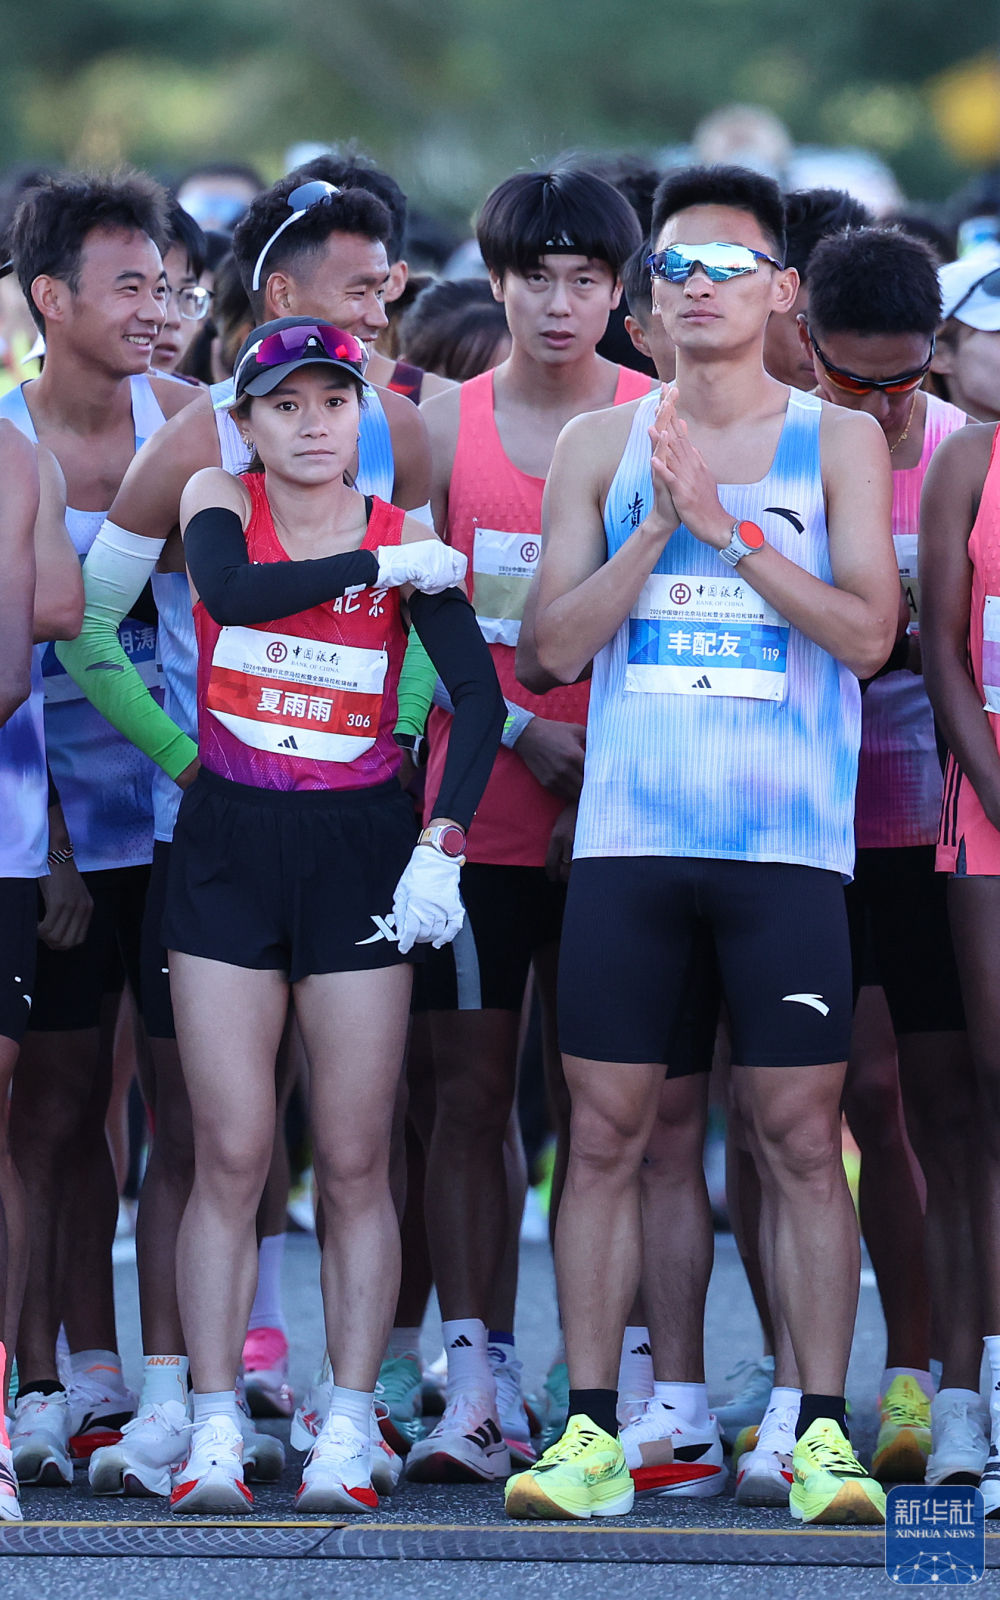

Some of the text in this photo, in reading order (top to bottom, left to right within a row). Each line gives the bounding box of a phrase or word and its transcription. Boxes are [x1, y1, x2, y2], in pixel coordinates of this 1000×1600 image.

[696, 584, 745, 600] 中国银行
[667, 630, 742, 658] 丰配友
[292, 645, 342, 666] 中国银行
[761, 647, 780, 662] 119
[291, 660, 308, 668] BANK
[319, 664, 340, 673] CHINA
[256, 687, 334, 722] 夏雨雨
[346, 713, 371, 728] 306
[147, 1356, 180, 1366] ANTA
